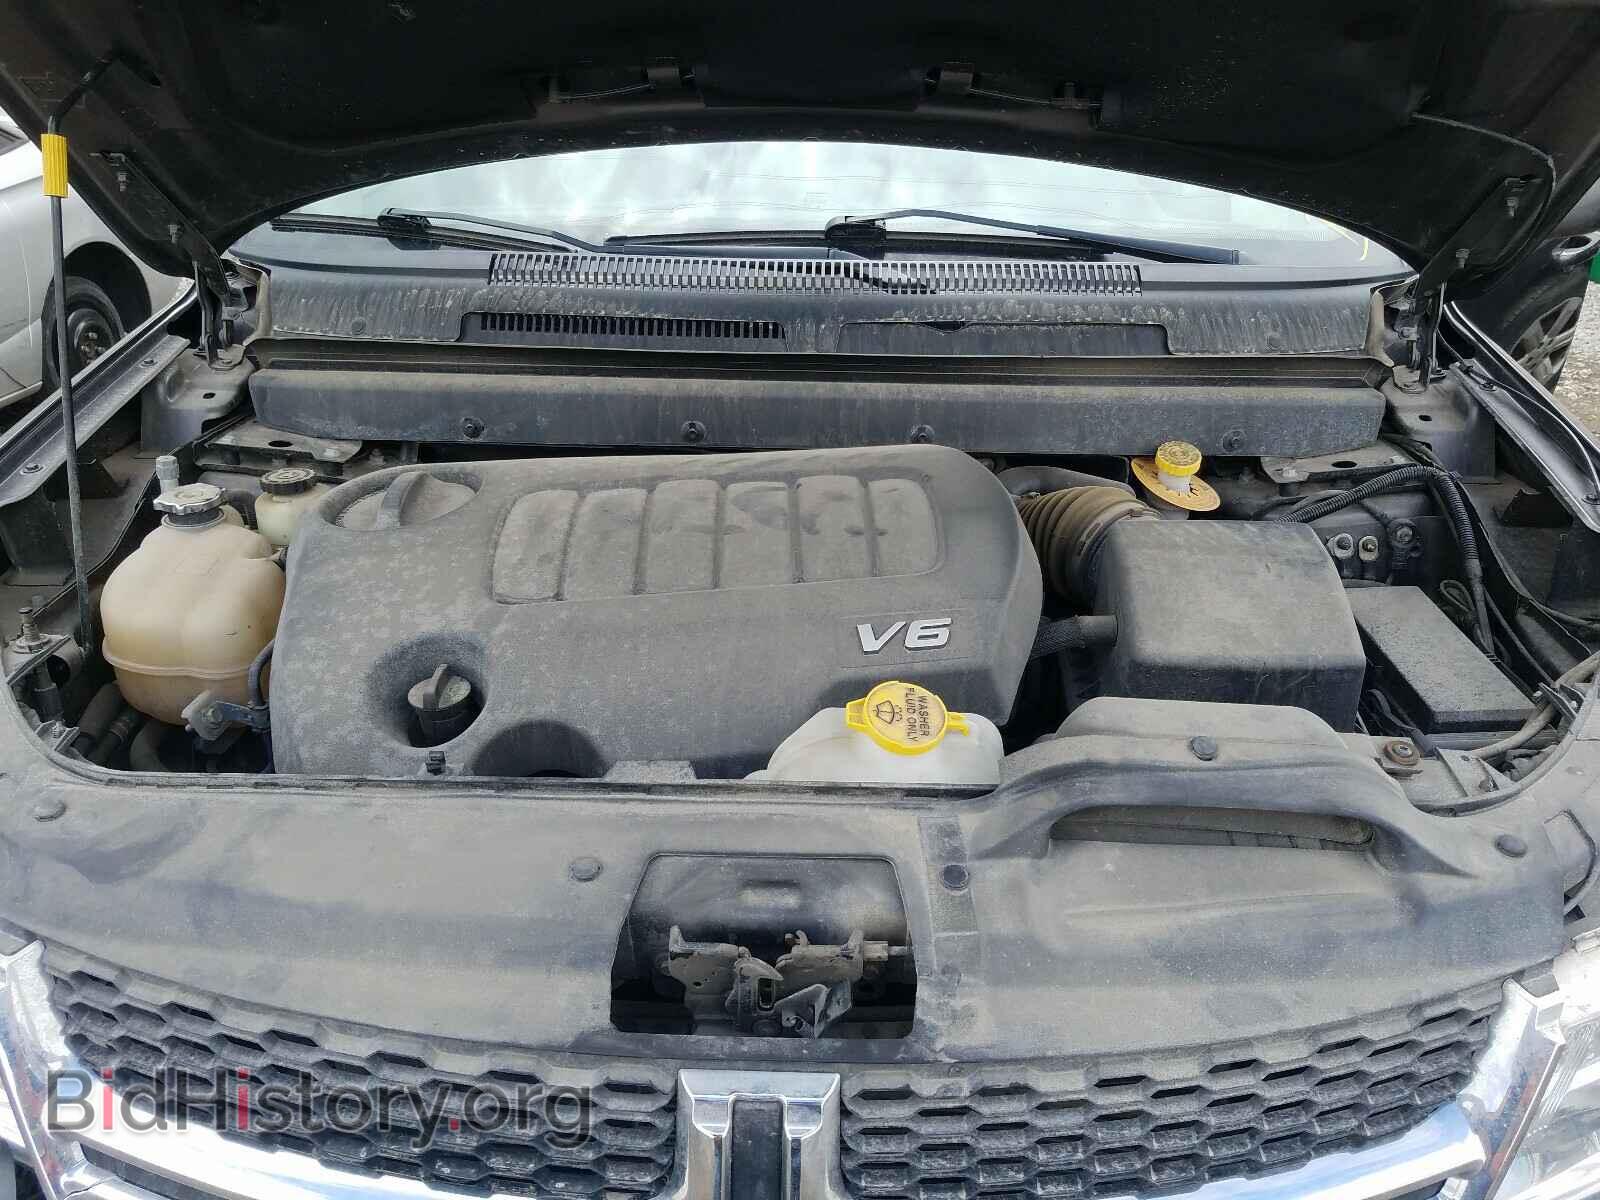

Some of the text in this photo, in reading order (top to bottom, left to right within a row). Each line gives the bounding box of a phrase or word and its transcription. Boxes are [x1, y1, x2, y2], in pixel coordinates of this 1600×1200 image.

[856, 618, 951, 654] V6
[905, 687, 918, 741] FLUID ONLY
[918, 695, 930, 736] WASHER
